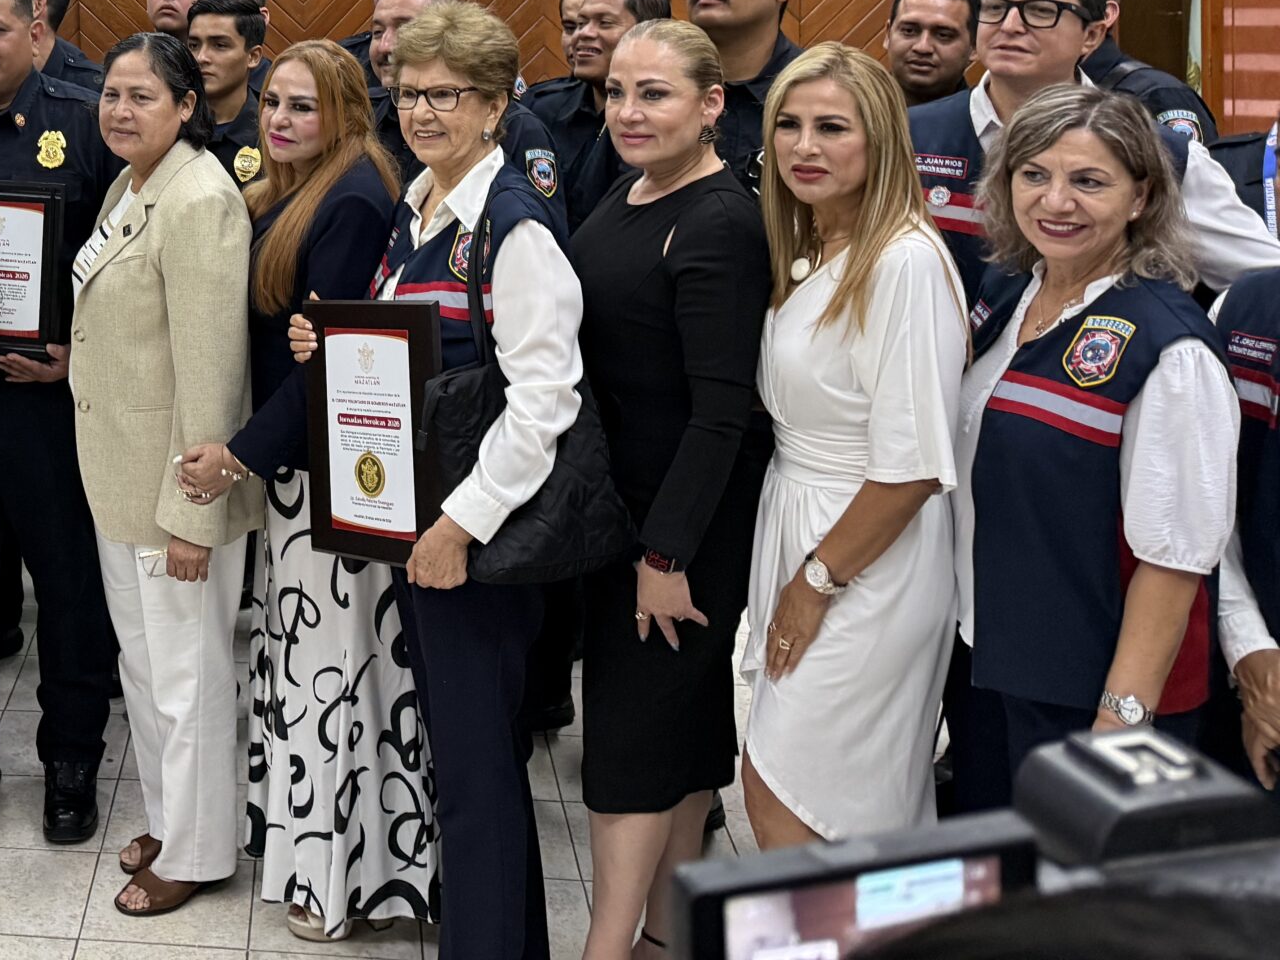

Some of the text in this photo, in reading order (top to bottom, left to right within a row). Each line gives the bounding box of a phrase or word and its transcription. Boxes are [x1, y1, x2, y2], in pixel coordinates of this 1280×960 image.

[924, 157, 944, 166] JUAN
[339, 415, 363, 425] Jornadas
[362, 417, 386, 427] Heroicas
